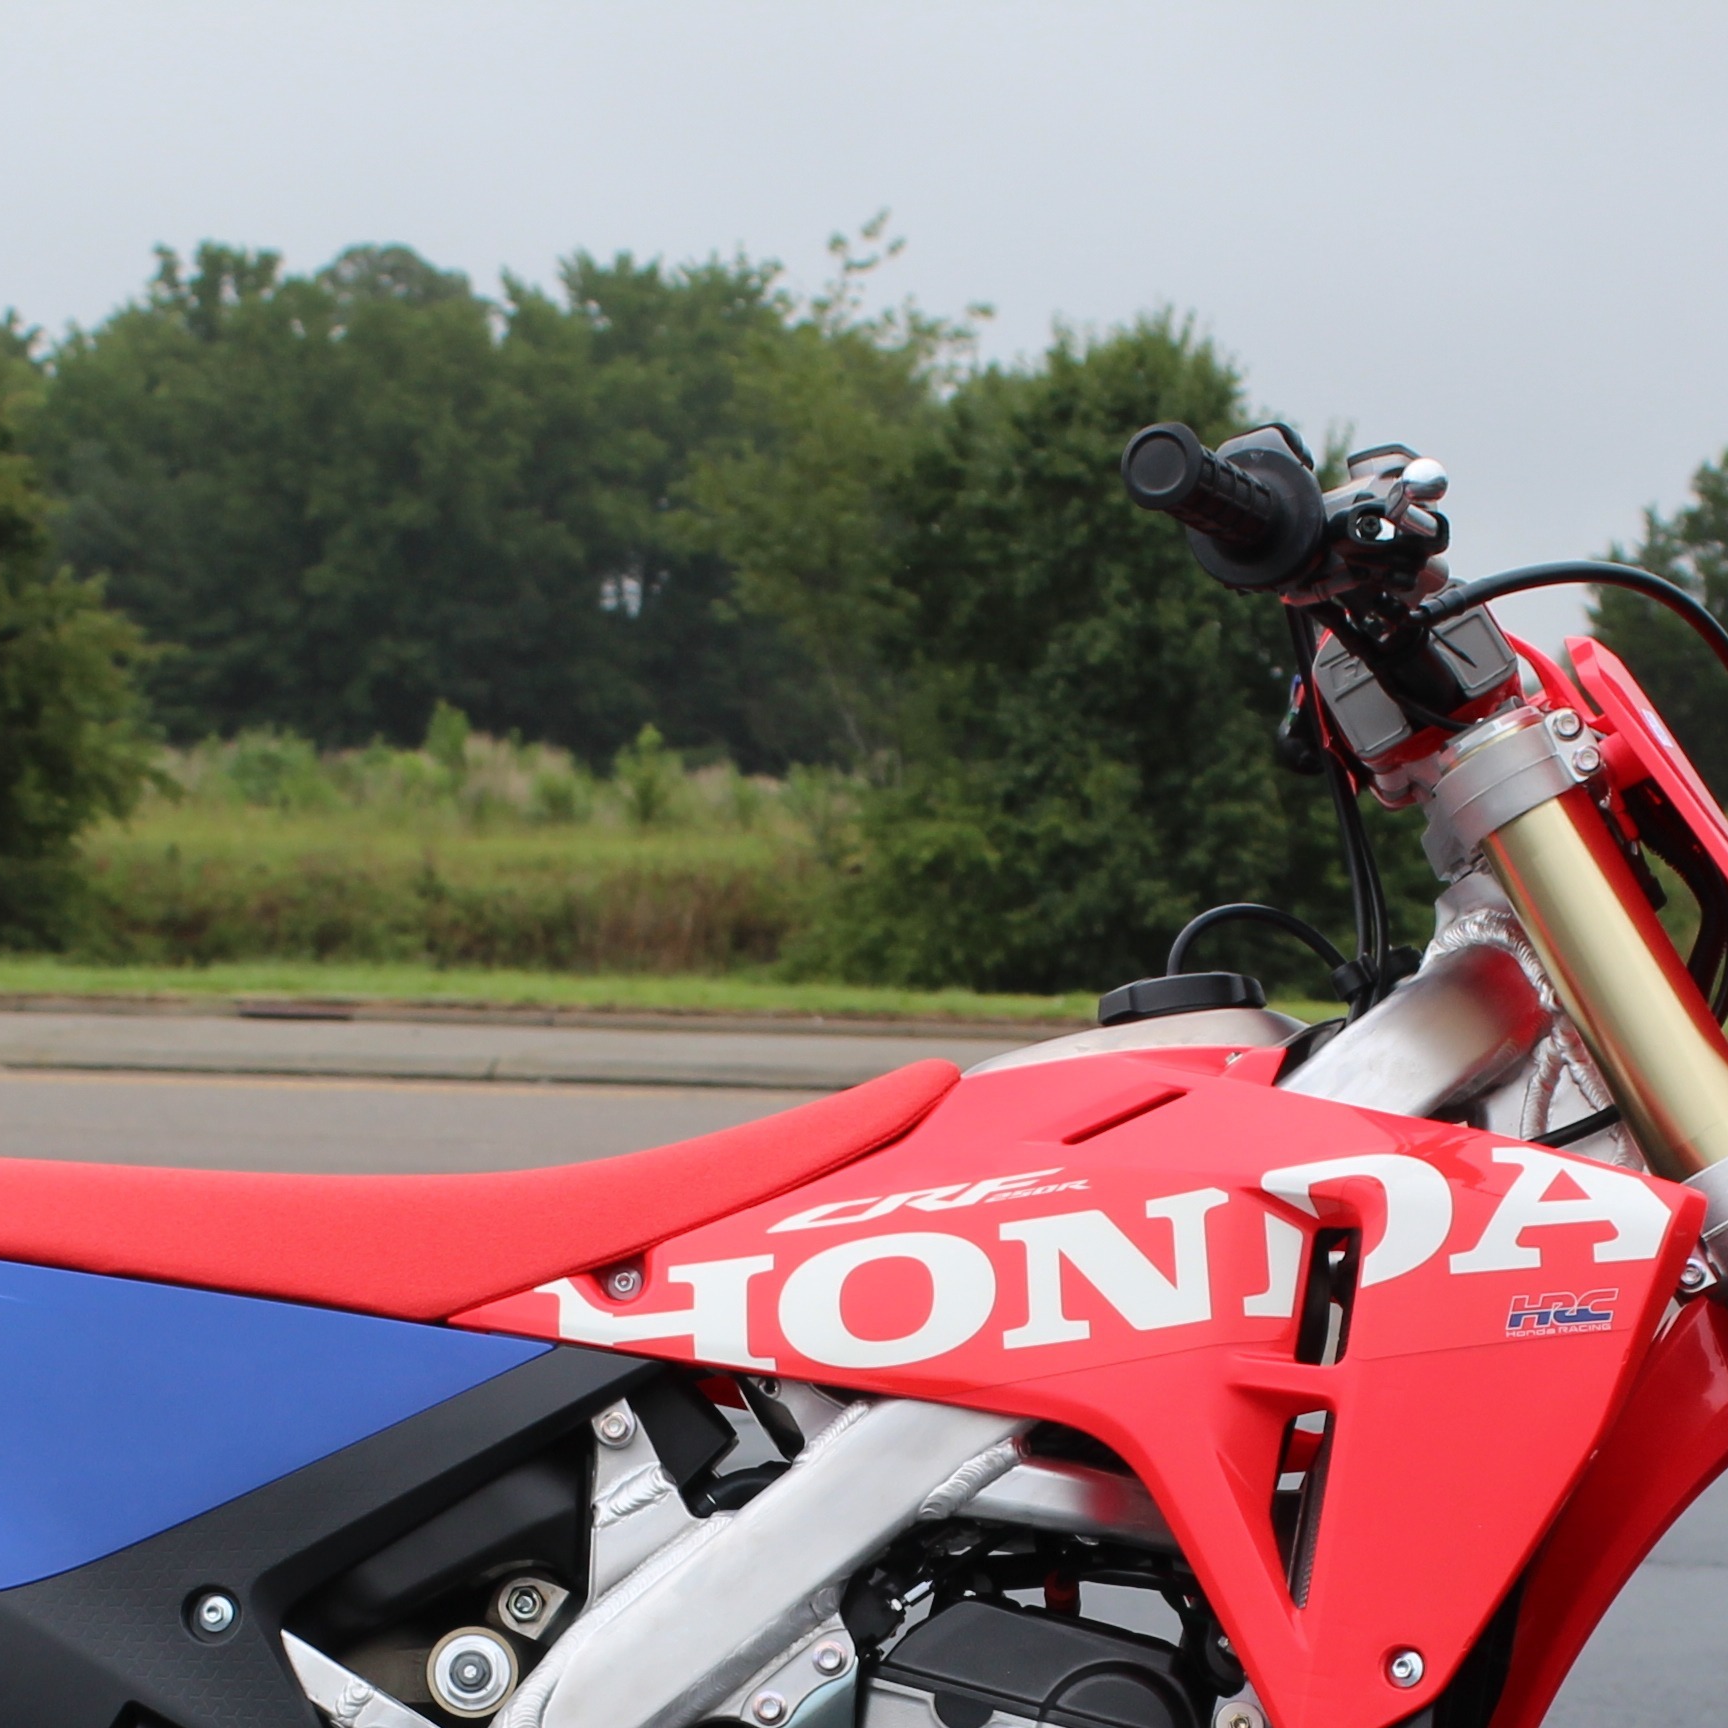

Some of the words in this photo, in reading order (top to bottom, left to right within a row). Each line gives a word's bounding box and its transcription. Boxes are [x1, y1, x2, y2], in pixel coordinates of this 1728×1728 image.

[766, 1167, 1066, 1234] CRF
[984, 1179, 1091, 1203] 250R
[535, 1146, 1671, 1371] HONDA
[1505, 1288, 1619, 1330] HRC
[1505, 1327, 1556, 1338] Honda
[1557, 1322, 1612, 1333] RACING
